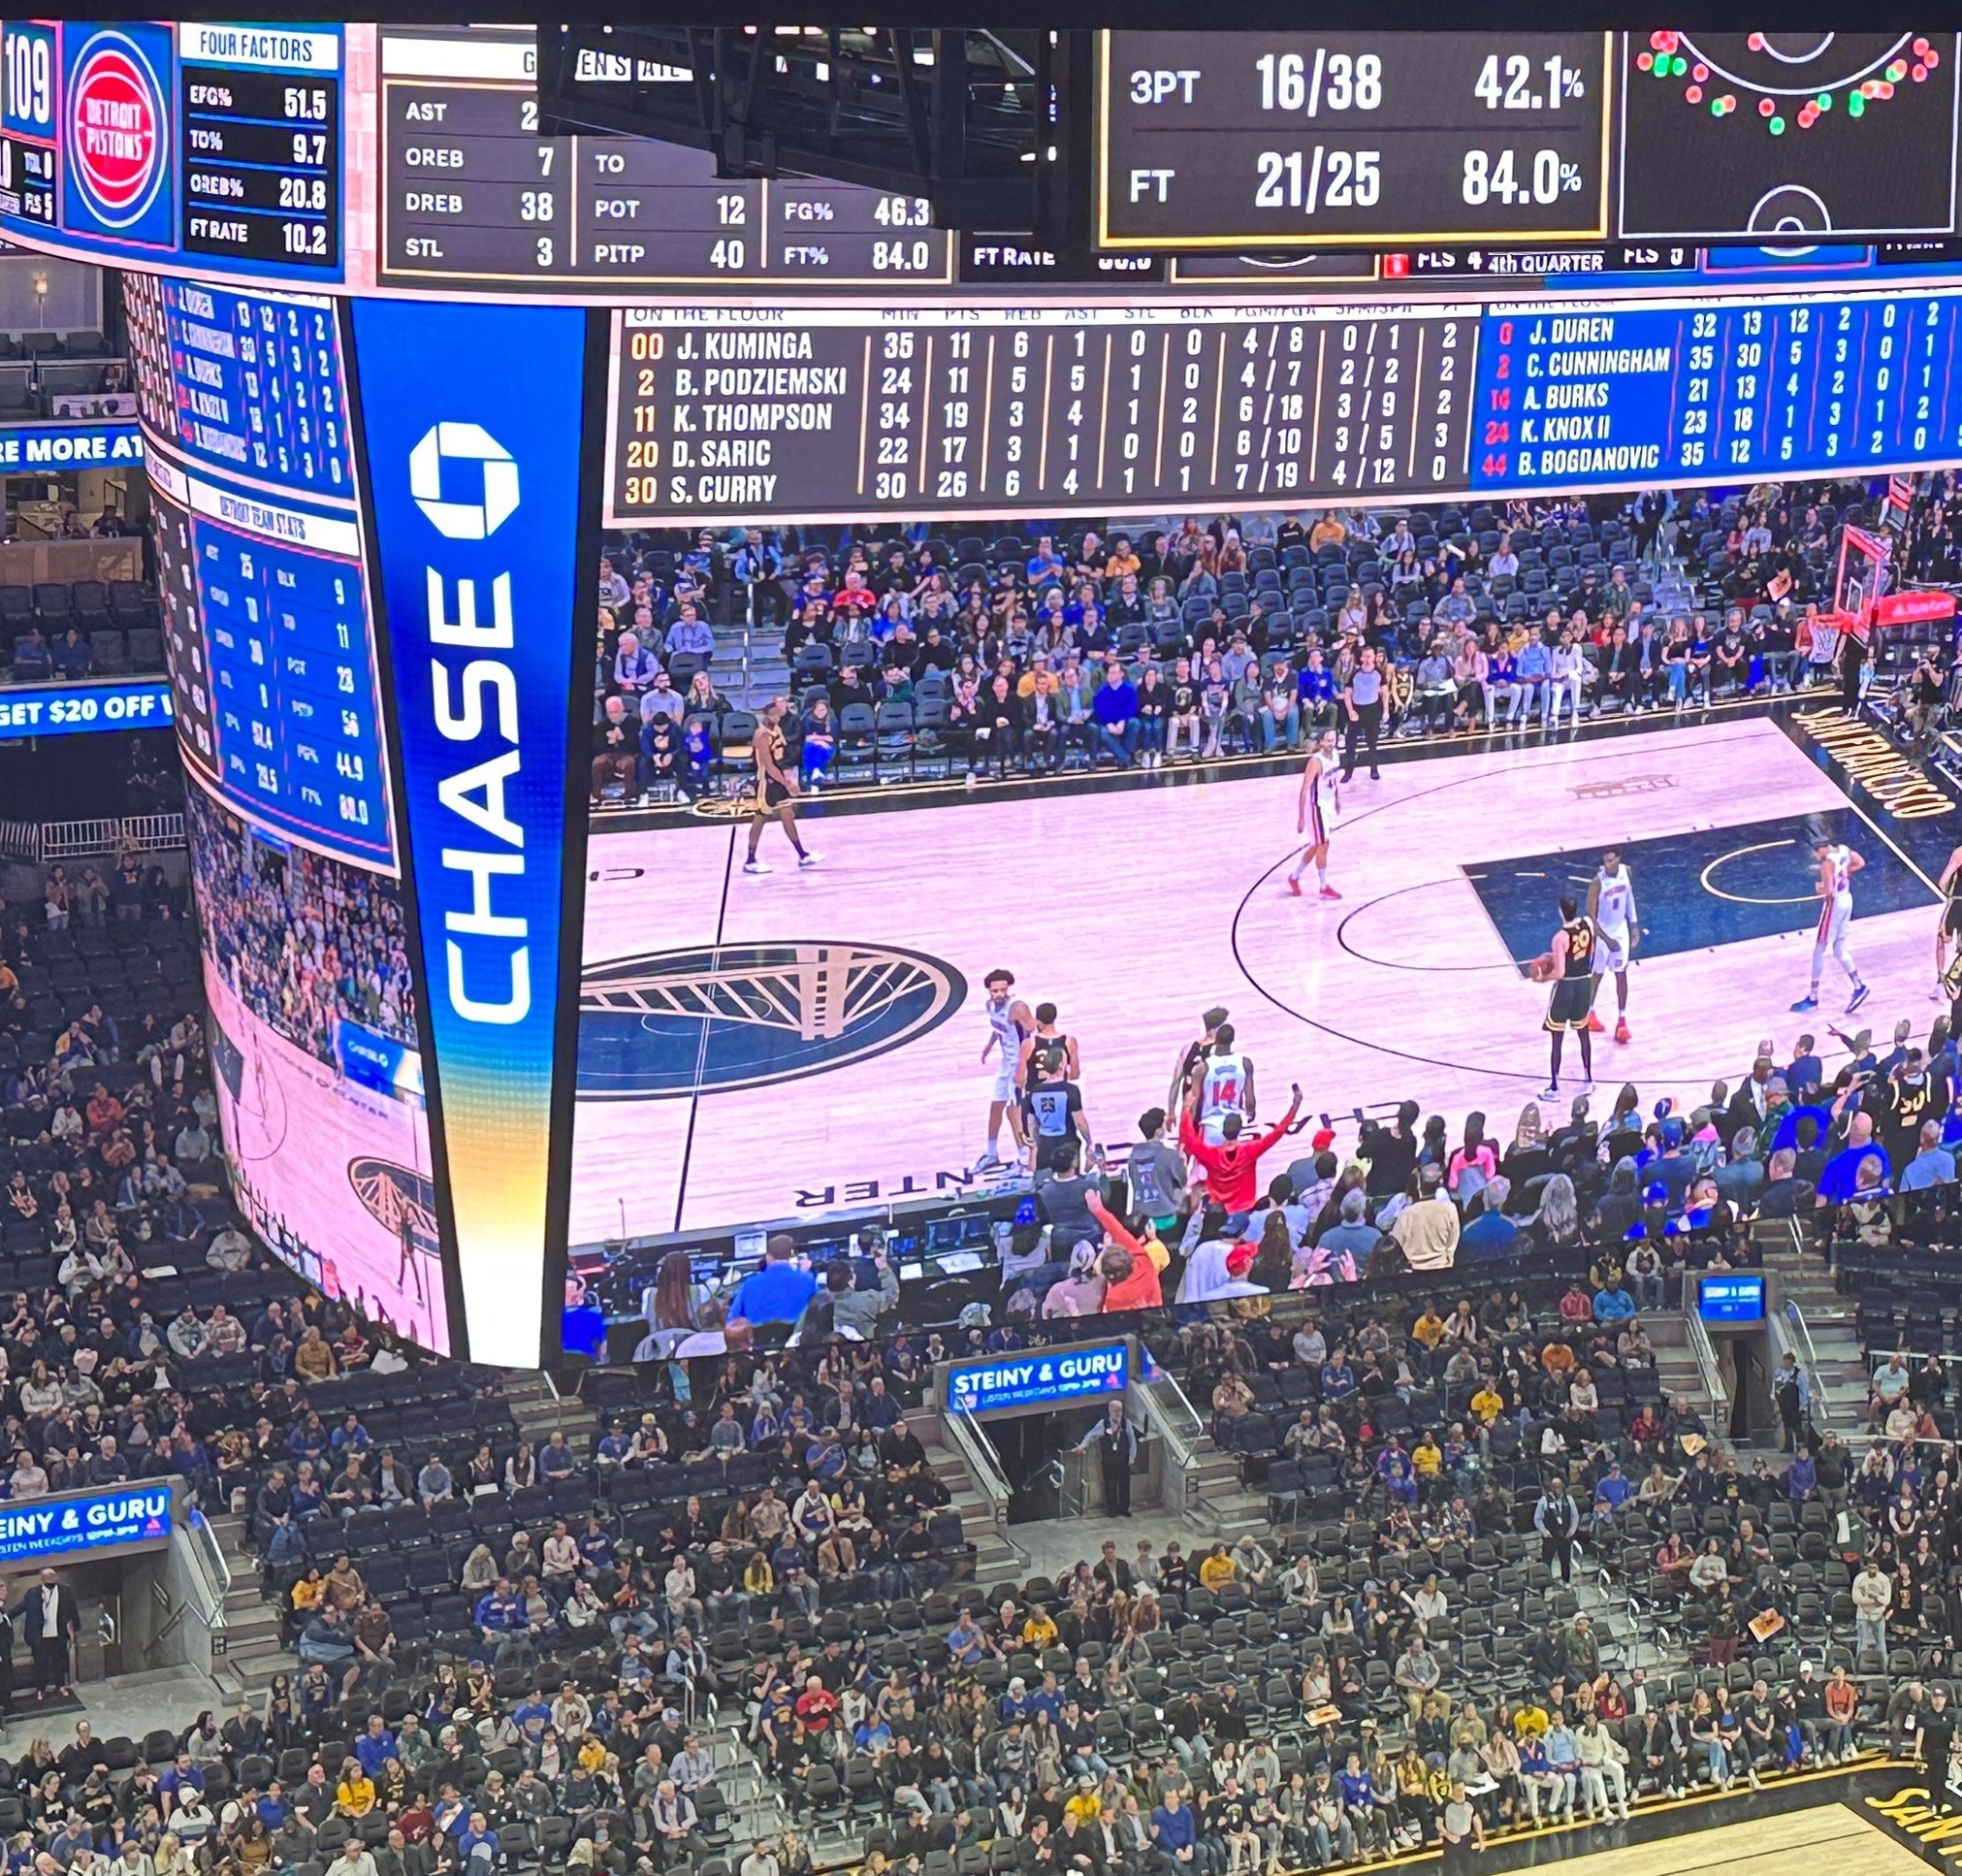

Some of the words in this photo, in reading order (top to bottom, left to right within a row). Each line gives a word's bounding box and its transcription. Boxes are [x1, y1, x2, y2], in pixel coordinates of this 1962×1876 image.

[200, 30, 238, 58] FOUR
[241, 34, 313, 63] FACTORS
[6, 33, 49, 123] 109
[1131, 71, 1201, 104] 3PT
[1256, 49, 1381, 117] 16/38
[1475, 55, 1584, 109] 42.1%
[85, 98, 142, 130] DETROIT
[190, 85, 232, 106] EFG%
[285, 88, 326, 119] 51.5
[406, 103, 447, 121] AST
[86, 126, 143, 161] PISTONS
[190, 130, 223, 150] TO%
[294, 134, 326, 164] 9.7
[406, 147, 464, 167] OREB
[538, 147, 554, 176] 7
[595, 155, 625, 173] TO
[190, 175, 243, 197] OREB%
[279, 178, 326, 210] 20.8
[1131, 170, 1174, 202] FT
[1256, 146, 1379, 213] 21/25
[1463, 150, 1581, 205] 84.0%
[406, 193, 463, 212] DREB
[522, 192, 553, 220] 38
[595, 200, 640, 217] POT
[718, 196, 745, 224] 12
[786, 203, 833, 220] FG%
[874, 198, 928, 225] 46.3
[210, 221, 247, 242] RATE
[283, 223, 326, 254] 10.2
[406, 239, 443, 257] STL
[537, 238, 553, 266] 3
[595, 245, 644, 263] PITP
[710, 241, 744, 269] 40
[785, 247, 828, 264] FT%
[873, 242, 928, 270] 84.0
[975, 247, 999, 265] FT
[1488, 254, 1516, 273] 4th
[1522, 255, 1602, 273] QUARTER
[1529, 320, 1546, 344] J.
[1552, 318, 1614, 343] DUREN
[1692, 313, 1717, 338] 32
[1743, 311, 1761, 335] 13
[1790, 308, 1809, 333] 12
[1839, 307, 1850, 330] 2
[1883, 305, 1895, 328] 0
[1927, 302, 1939, 325] 2
[632, 333, 663, 360] 00
[677, 333, 698, 359] J.
[706, 333, 812, 359] KUMINGA
[885, 332, 914, 358] 35
[950, 332, 970, 358] 11
[1014, 332, 1028, 357] 6
[1075, 331, 1084, 357] 1
[1131, 330, 1145, 356] 0
[1187, 329, 1202, 355] 0
[1442, 323, 1457, 348] 2
[1528, 353, 1544, 377] C.
[1549, 347, 1670, 376] CUNNINGHAM
[1689, 345, 1713, 370] 35
[1737, 343, 1761, 368] 30
[1790, 340, 1802, 365] 5
[1836, 339, 1847, 362] 3
[1881, 336, 1892, 359] 0
[1926, 334, 1933, 356] 1
[638, 370, 654, 396] 2
[676, 370, 698, 396] B.
[705, 368, 846, 396] PODZIEMSKI
[882, 368, 912, 394] 24
[949, 368, 968, 393] 11
[1012, 367, 1026, 392] 5
[1071, 366, 1084, 391] 5
[1131, 365, 1141, 390] 1
[1185, 364, 1199, 389] 0
[1440, 356, 1454, 380] 2
[1524, 386, 1541, 410] A.
[1546, 383, 1609, 408] BURKS
[1689, 378, 1708, 402] 21
[1737, 375, 1755, 400] 13
[1786, 372, 1798, 396] 4
[1832, 371, 1844, 394] 2
[1878, 368, 1889, 391] 0
[1923, 365, 1930, 388] 1
[634, 405, 655, 432] 11
[674, 404, 696, 432] K.
[702, 404, 832, 431] THOMPSON
[880, 403, 910, 429] 34
[945, 403, 968, 428] 19
[1010, 402, 1023, 427] 3
[1068, 401, 1082, 426] 4
[1129, 399, 1138, 425] 1
[1182, 398, 1197, 423] 2
[1437, 390, 1451, 414] 2
[1521, 419, 1538, 442] K.
[1544, 416, 1594, 441] KNOX
[1597, 415, 1610, 438] II
[1683, 410, 1707, 435] 23
[1734, 407, 1753, 431] 18
[1786, 404, 1793, 428] 1
[1829, 402, 1841, 425] 3
[1877, 400, 1883, 422] 1
[1917, 396, 1929, 419] 2
[27, 437, 106, 462] MORE
[112, 436, 143, 458] AT
[627, 441, 659, 468] 20
[673, 441, 695, 468] D.
[701, 439, 770, 467] SARIC
[878, 437, 908, 464] 22
[943, 437, 967, 463] 17
[1008, 436, 1021, 461] 3
[1069, 435, 1077, 460] 1
[1124, 434, 1139, 459] 0
[1180, 432, 1195, 457] 0
[1435, 423, 1448, 447] 3
[1519, 452, 1536, 475] B.
[1541, 445, 1659, 474] BOGDANOVIC
[1681, 442, 1704, 467] 35
[1731, 439, 1750, 463] 12
[1782, 437, 1792, 460] 5
[1826, 434, 1838, 457] 3
[1871, 431, 1882, 453] 2
[1914, 427, 1926, 450] 0
[626, 477, 657, 503] 30
[671, 476, 692, 503] S.
[699, 475, 777, 503] CURRY
[876, 472, 906, 499] 30
[937, 471, 967, 497] 26
[1006, 470, 1019, 496] 6
[1063, 469, 1078, 495] 4
[1124, 468, 1134, 493] 1
[1180, 466, 1190, 491] 1
[1432, 456, 1445, 480] 0
[0, 702, 43, 727] GET
[49, 698, 98, 725] $20
[104, 695, 154, 721] OFF
[1820, 734, 1956, 818] FRANCISCO
[427, 565, 531, 1024] CHASE
[1212, 1079, 1237, 1107] 14
[954, 1366, 1033, 1394] STEINY
[1039, 1364, 1053, 1381] &
[1059, 1353, 1123, 1378] GURU
[62, 1509, 80, 1530] &
[87, 1495, 165, 1525] GURU
